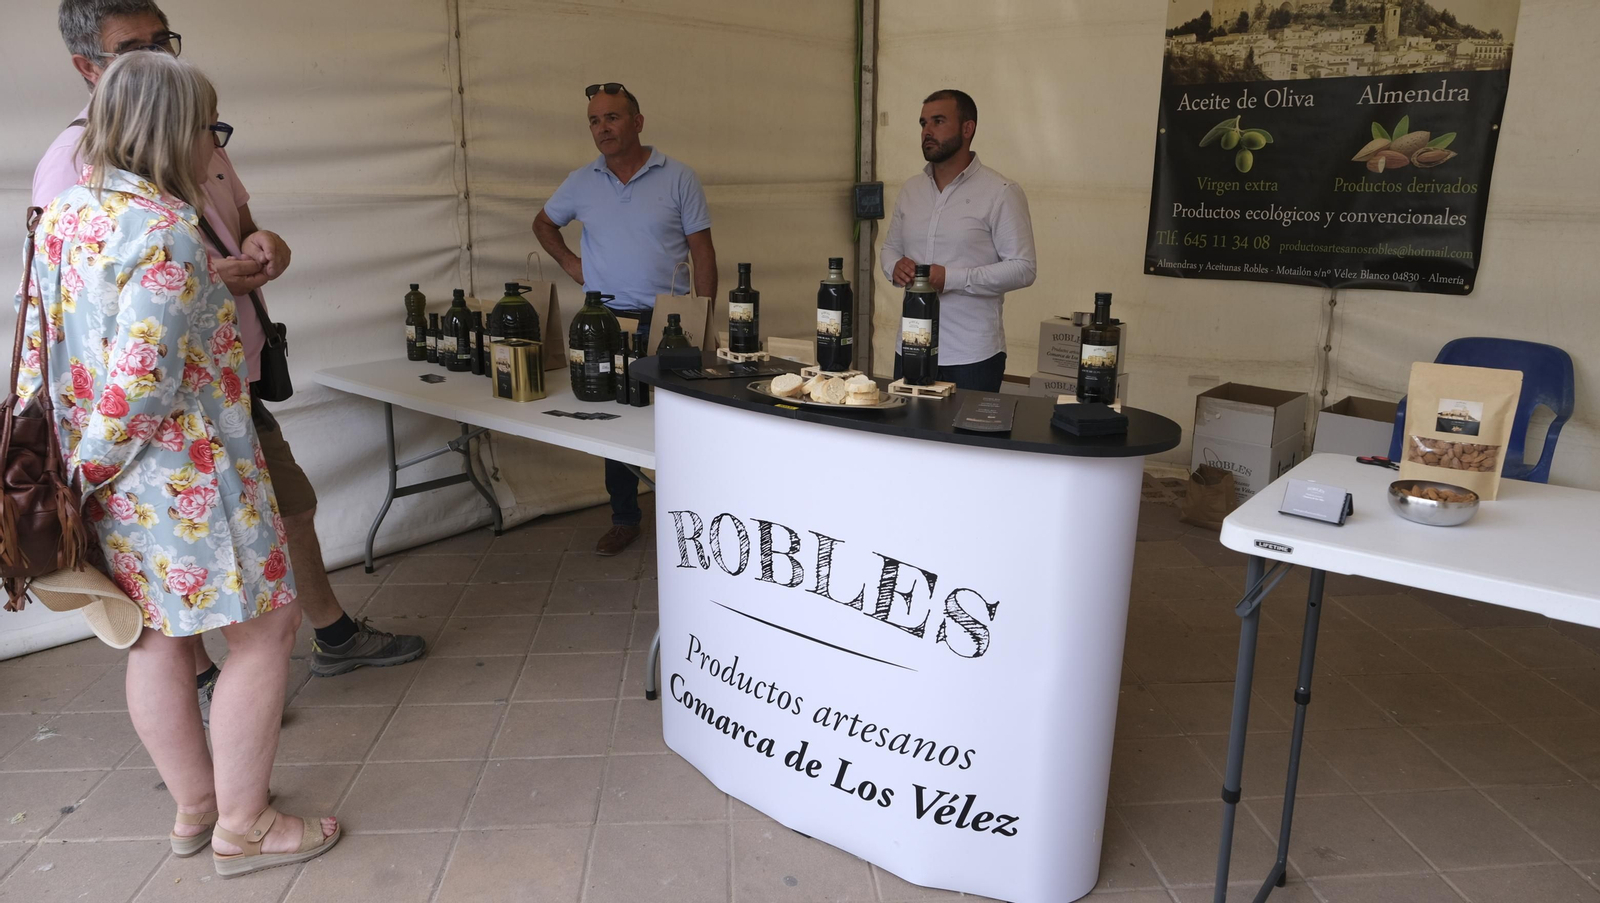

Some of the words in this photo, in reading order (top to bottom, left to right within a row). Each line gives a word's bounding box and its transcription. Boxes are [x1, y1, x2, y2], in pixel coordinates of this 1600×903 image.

[1177, 93, 1230, 111] Aceite
[1236, 89, 1257, 109] de
[1264, 87, 1315, 108] Oliva
[1356, 79, 1470, 105] Almendra
[1197, 176, 1240, 196] Virgen
[1244, 179, 1278, 192] extra
[1333, 176, 1402, 193] Productos
[1407, 176, 1478, 194] derivados
[1172, 202, 1241, 220] Productos
[1245, 204, 1320, 227] ecológicos
[1323, 211, 1335, 228] y
[1339, 208, 1467, 226] convencionales
[1156, 230, 1179, 246] Tlf.
[1184, 232, 1207, 249] 645
[1213, 235, 1227, 248] 11
[1232, 236, 1249, 250] 34
[1253, 235, 1271, 250] 08
[1279, 239, 1473, 259] productosartesanosrobles@hotmail.com
[1157, 259, 1198, 270] Almendras
[1199, 263, 1203, 272] y
[1205, 261, 1242, 273] Aceitunas
[1243, 263, 1269, 275] Robles
[1276, 264, 1312, 277] Motailón
[1314, 267, 1331, 278] s/nº
[1334, 268, 1357, 279] Vélez
[1360, 269, 1390, 281] Blanco
[1392, 271, 1420, 283] 04830
[1428, 273, 1464, 286] Almería
[1052, 333, 1081, 344] ROBLE
[1208, 460, 1252, 477] ROBLES
[1258, 541, 1288, 552] LIFETIME
[667, 510, 1000, 659] ROBLES
[685, 633, 804, 716] Productos
[812, 706, 976, 770] artesanos
[669, 673, 775, 758] Comarca
[784, 741, 823, 779] de
[830, 757, 895, 808] Los
[912, 784, 1020, 837] Vélez
